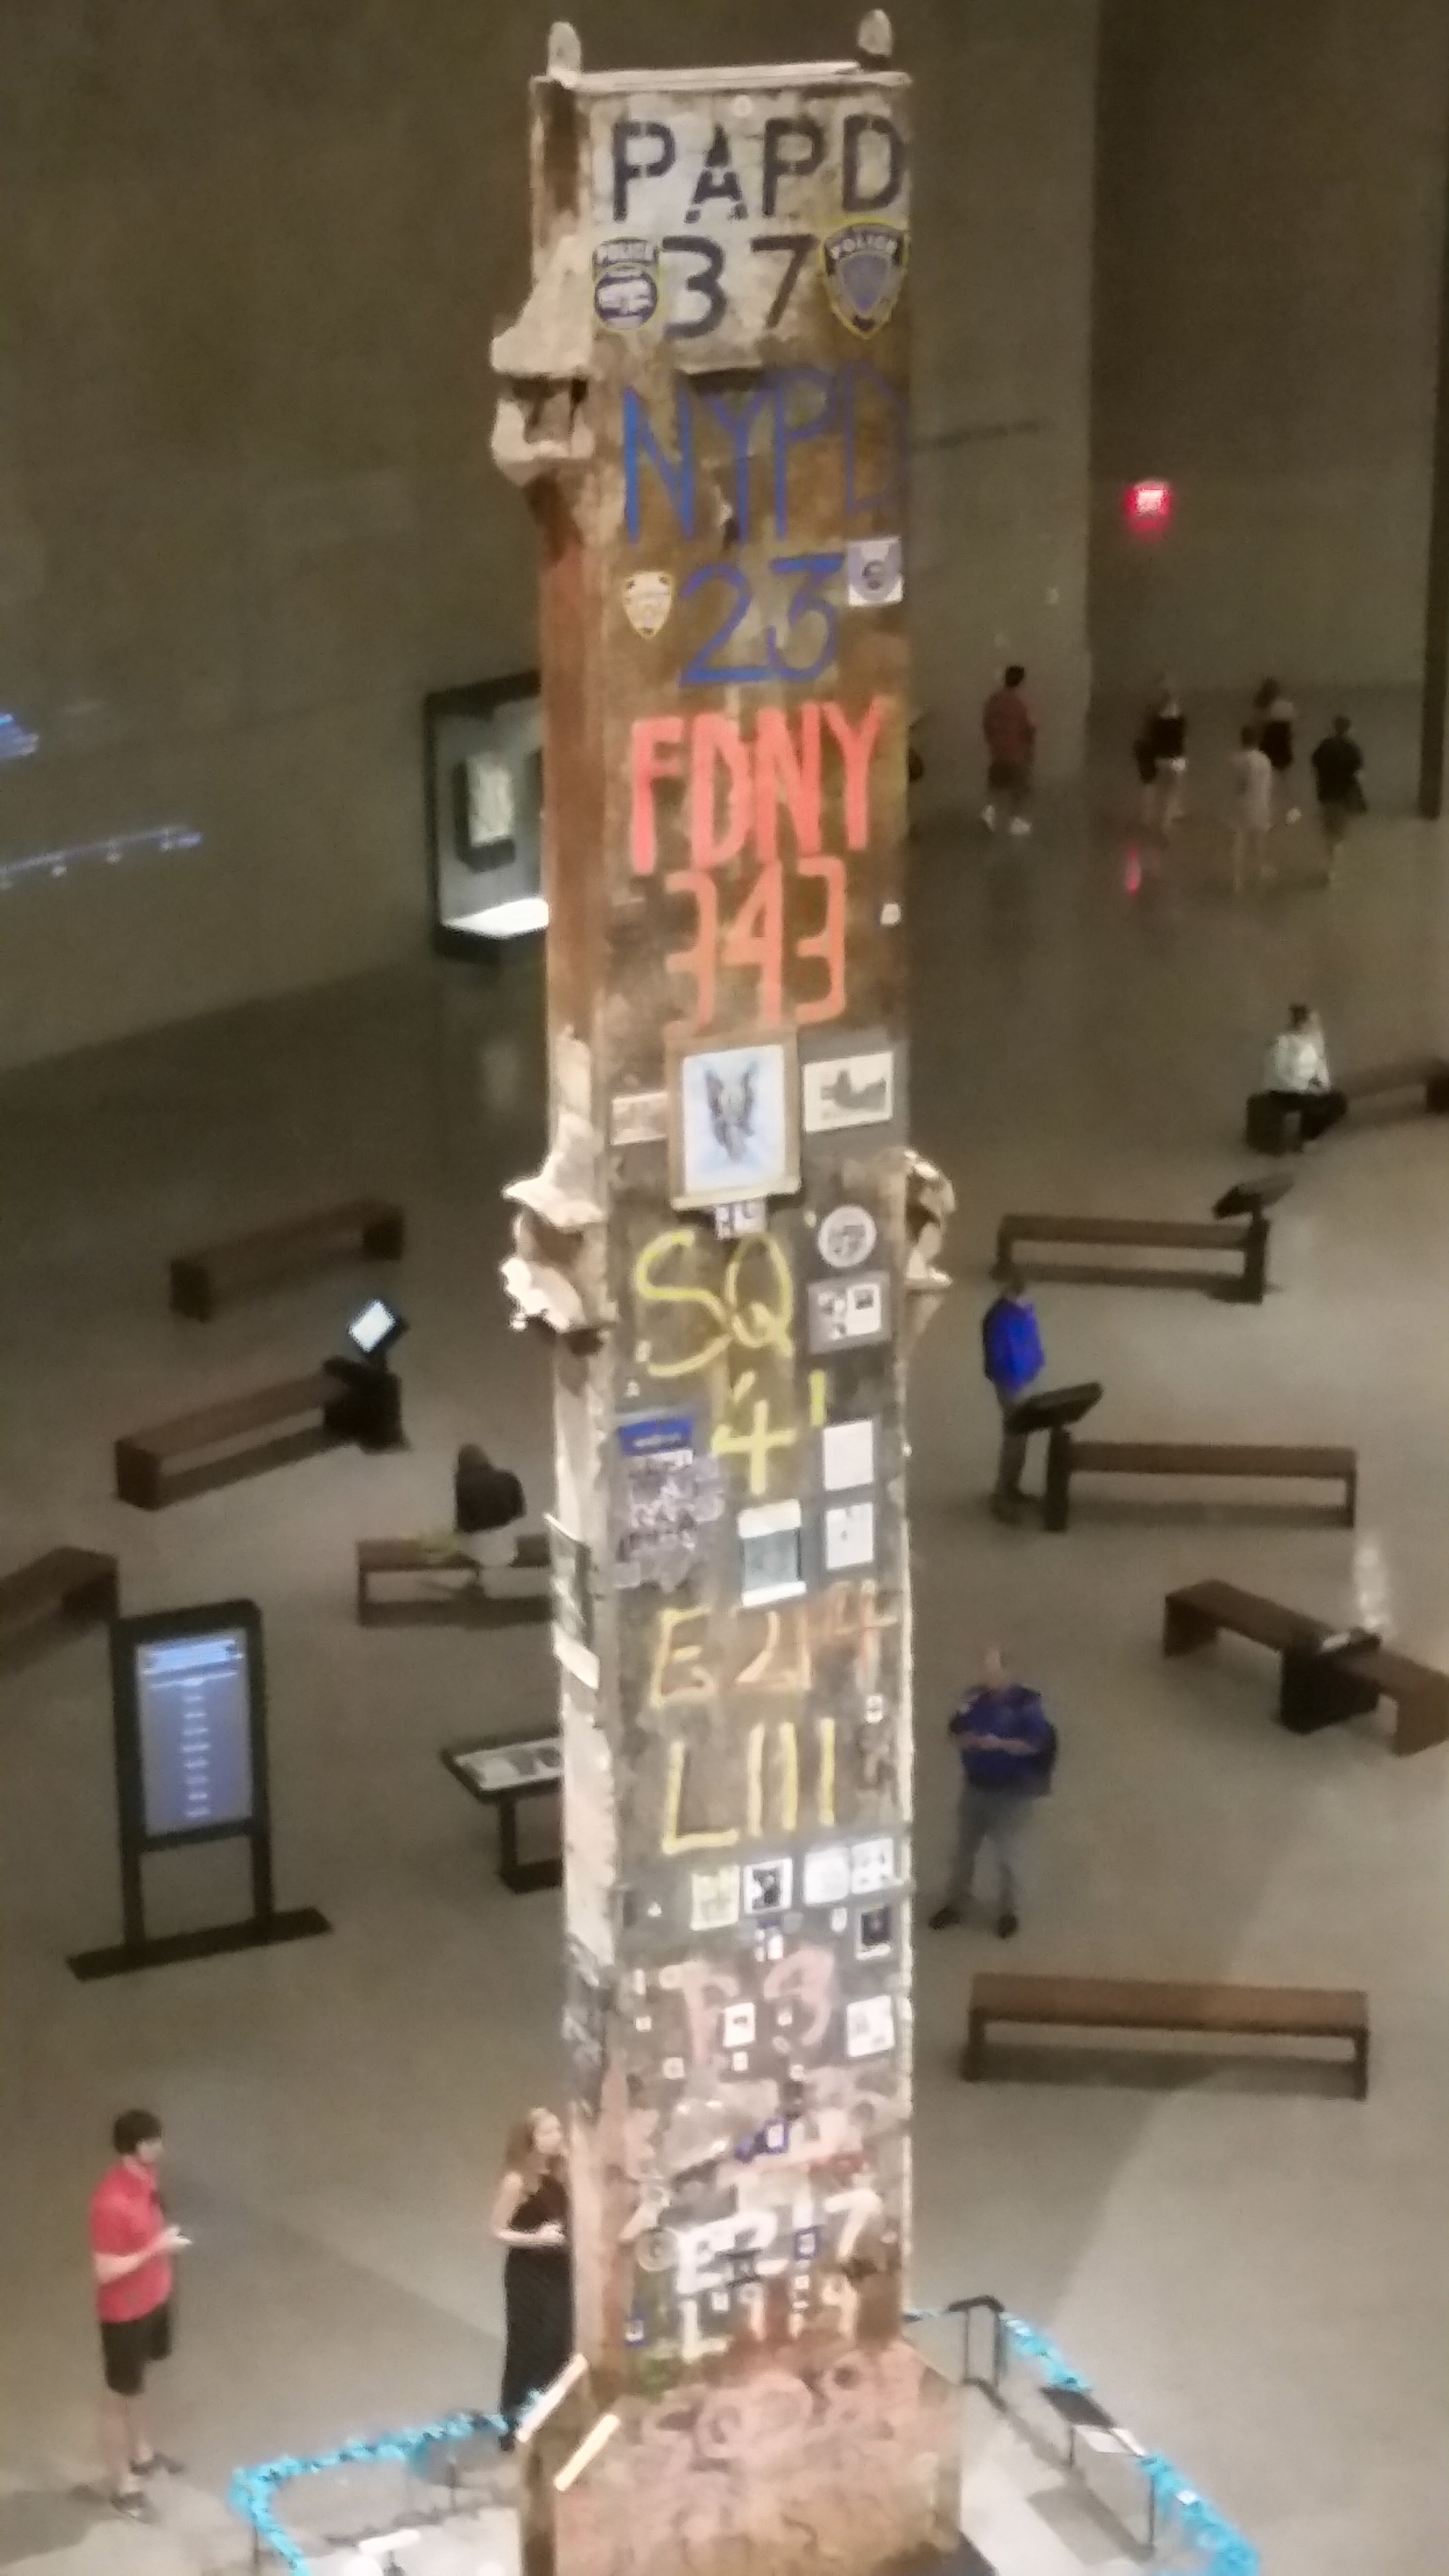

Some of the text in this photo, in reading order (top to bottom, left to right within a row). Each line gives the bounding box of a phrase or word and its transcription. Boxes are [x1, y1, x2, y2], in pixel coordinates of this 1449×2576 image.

[612, 113, 906, 224] PAPD
[661, 235, 821, 339] 37
[623, 360, 908, 544] NYPD
[678, 552, 845, 687] 23
[631, 695, 895, 877] FDNY
[662, 855, 847, 1042] 343
[634, 1229, 795, 1376] SQ
